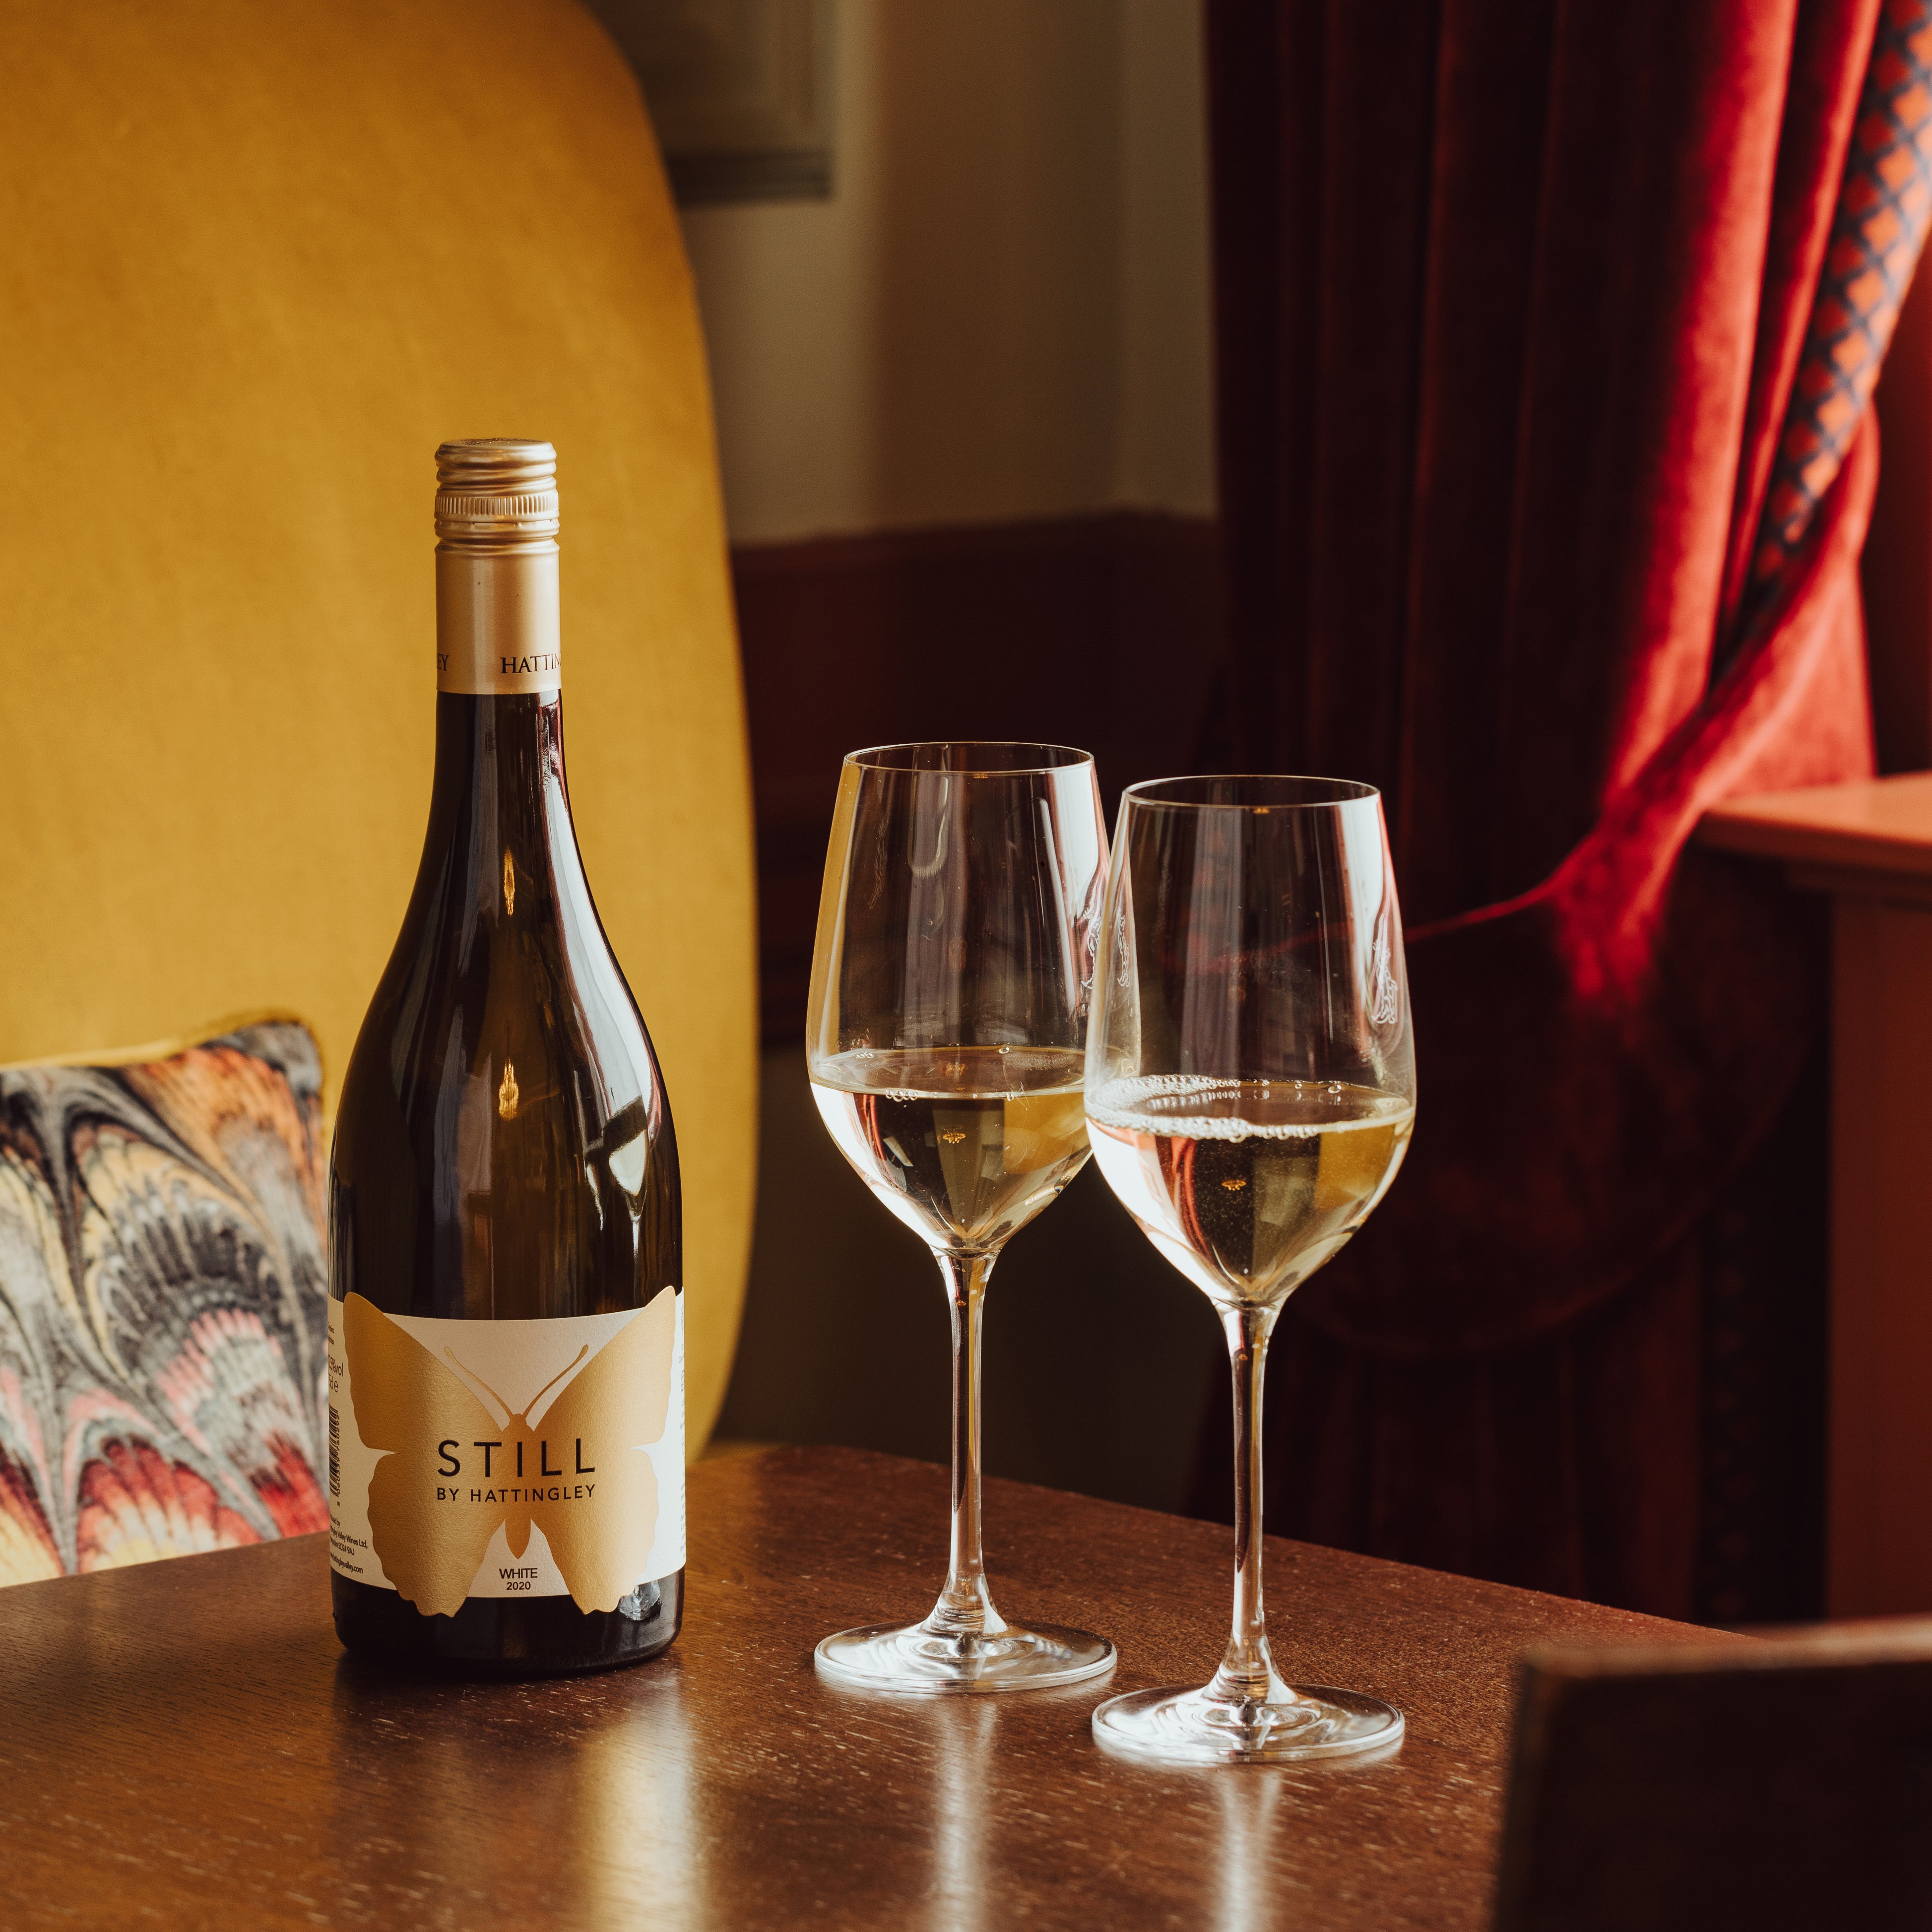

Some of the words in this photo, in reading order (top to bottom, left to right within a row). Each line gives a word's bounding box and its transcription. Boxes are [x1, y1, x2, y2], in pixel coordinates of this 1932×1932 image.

[500, 651, 562, 674] HATTIN
[437, 1438, 595, 1478] STILL
[437, 1487, 459, 1501] BY
[470, 1484, 595, 1502] HATTINGLEY
[346, 1534, 358, 1546] Wines
[359, 1539, 368, 1549] Ltd,
[499, 1568, 538, 1579] WHITE
[506, 1581, 531, 1591] 2020
